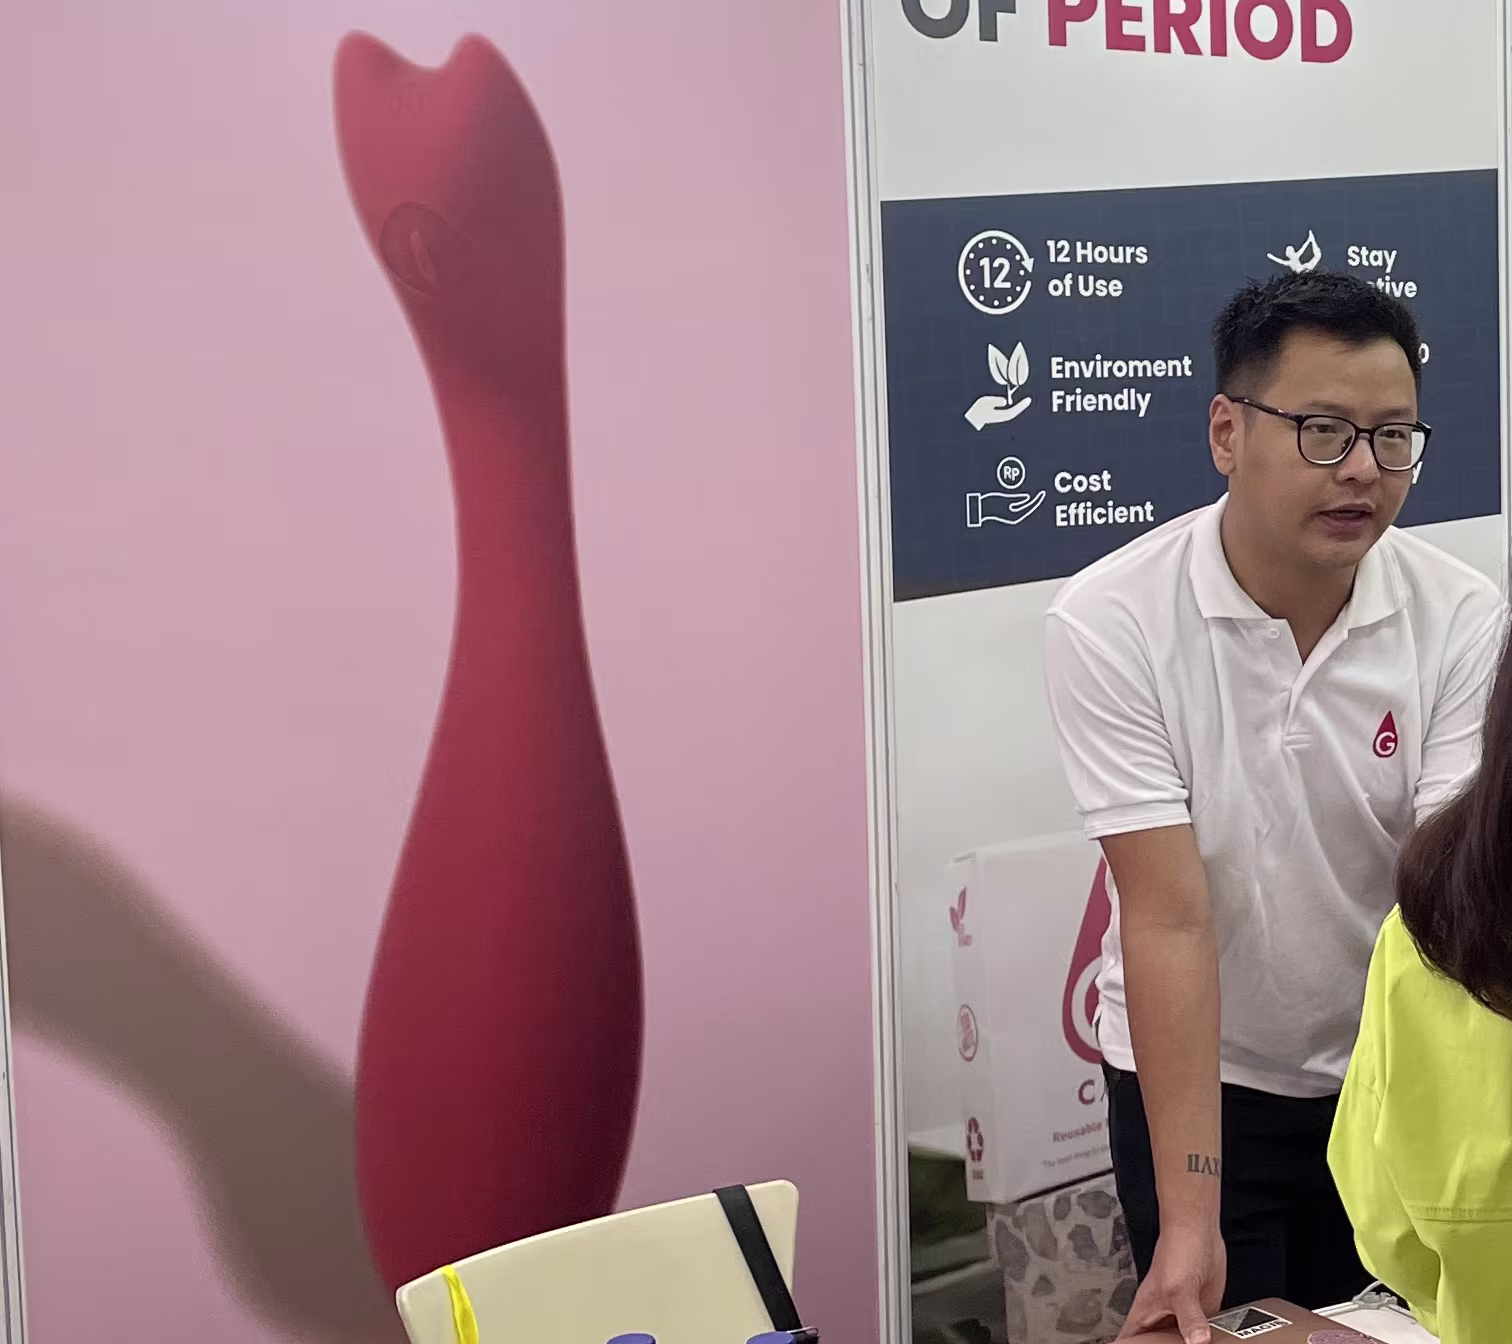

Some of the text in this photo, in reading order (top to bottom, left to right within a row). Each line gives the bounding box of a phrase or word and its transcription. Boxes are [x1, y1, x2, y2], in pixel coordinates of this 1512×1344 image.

[1046, 240, 1148, 265] 12 Hours
[1347, 244, 1398, 272] Stay
[979, 256, 1011, 291] 12
[1048, 274, 1123, 298] of Use
[1050, 353, 1192, 380] Enviroment
[1051, 386, 1152, 418] Friendly
[1054, 469, 1112, 494] Cost
[1055, 499, 1155, 527] Efficient
[1375, 731, 1396, 756] G
